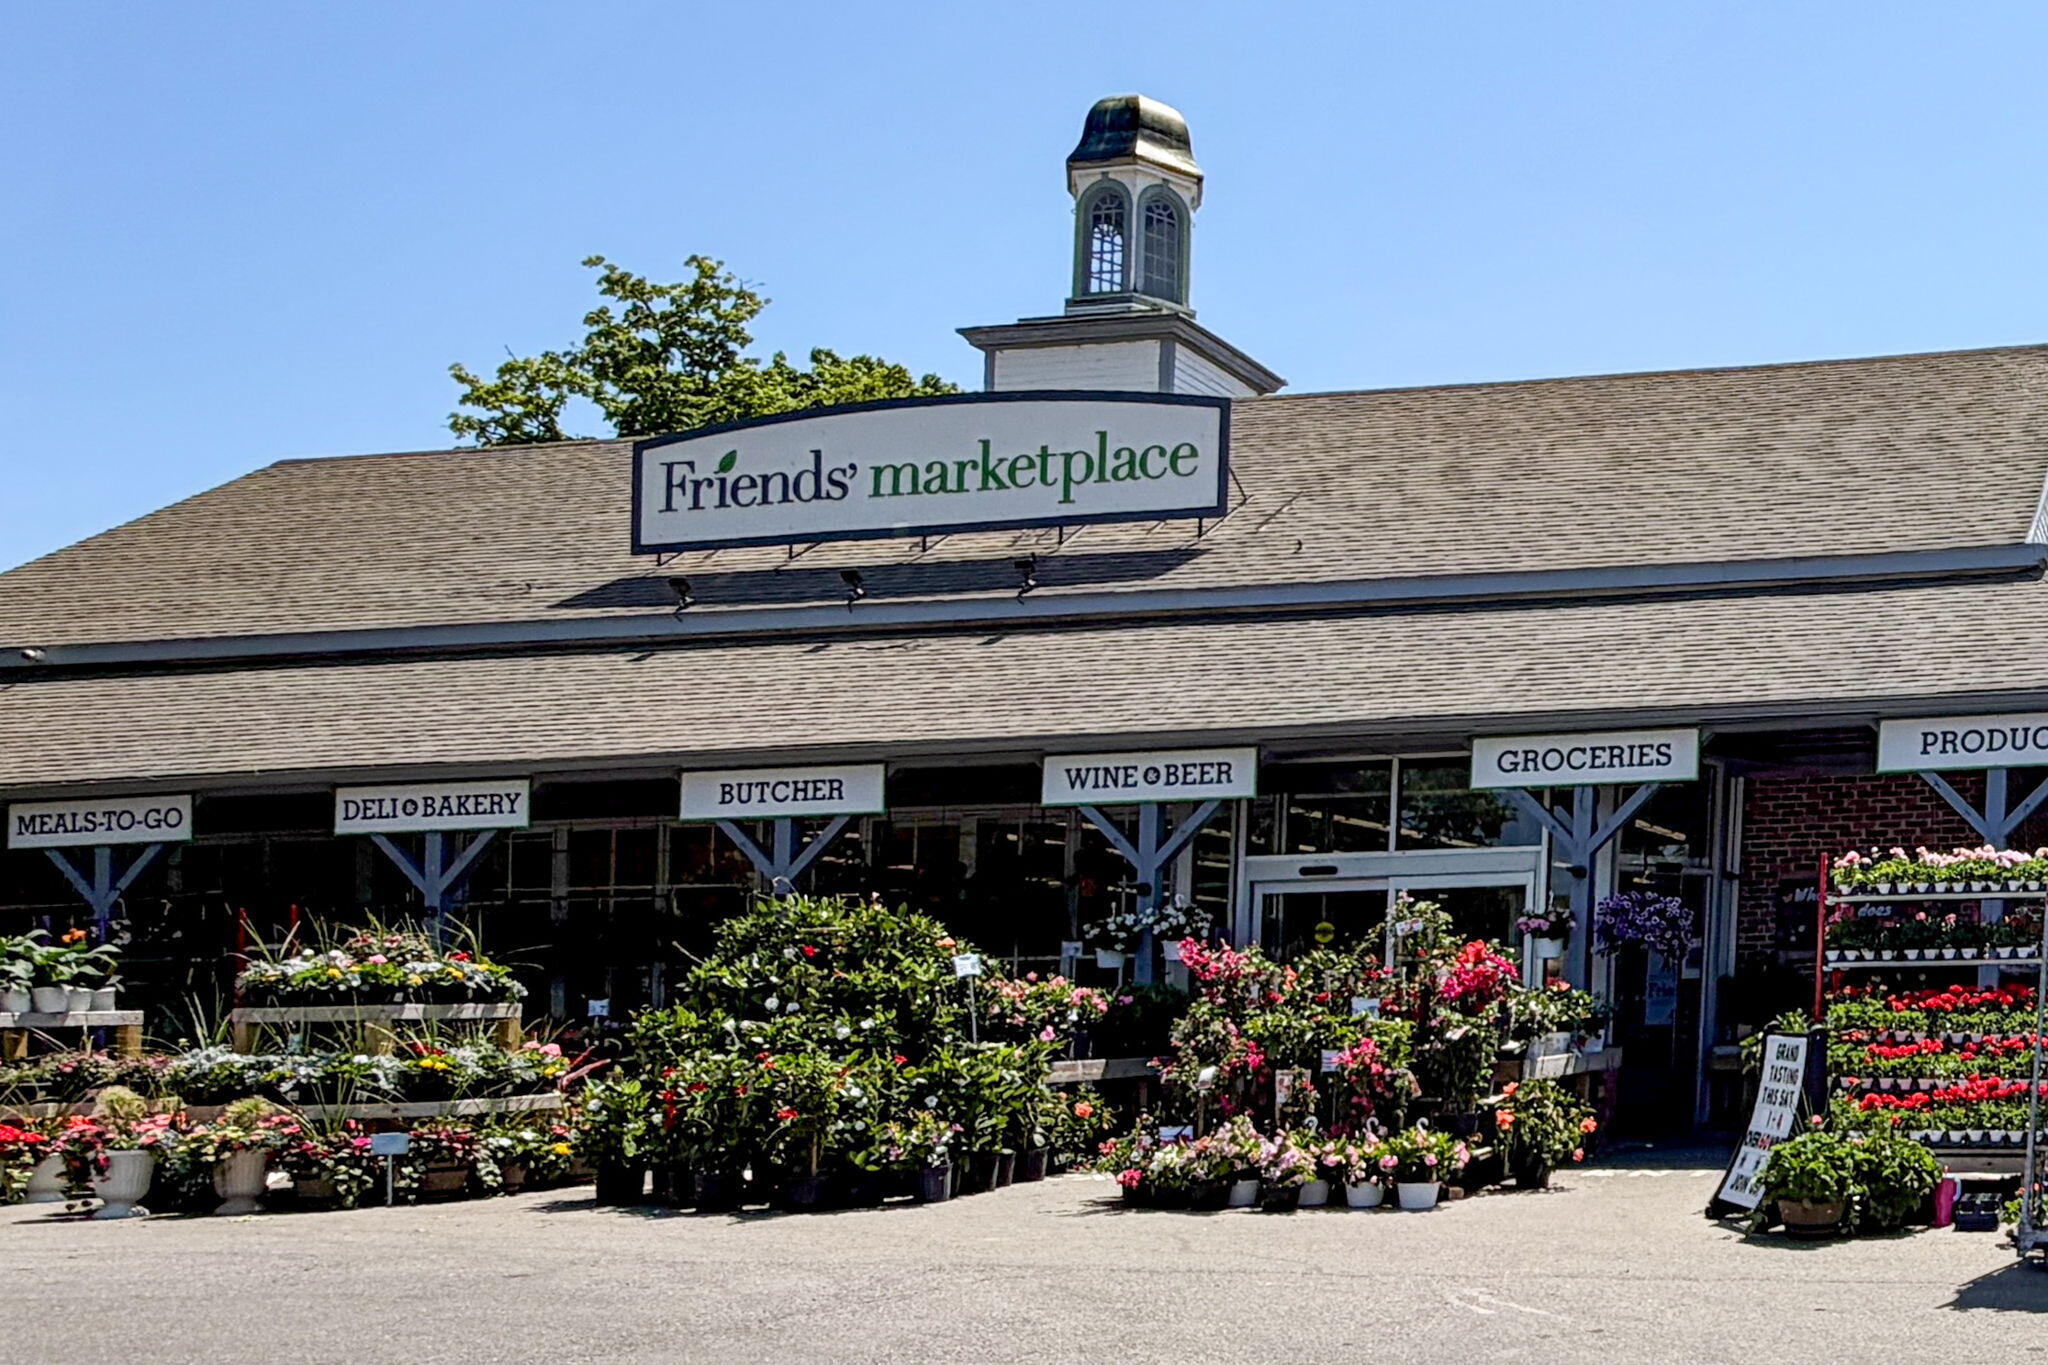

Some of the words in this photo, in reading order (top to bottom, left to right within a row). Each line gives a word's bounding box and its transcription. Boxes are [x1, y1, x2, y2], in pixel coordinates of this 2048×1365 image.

[868, 430, 1199, 504] marketplace
[1497, 743, 1672, 773] GROCERIES
[1065, 766, 1138, 790] WINE
[1164, 762, 1232, 786] BEER
[719, 779, 844, 804] BUTCHER
[343, 798, 399, 820] DELI
[422, 793, 521, 817] BAKERY
[17, 807, 183, 835] MEALS-TO-GO
[1776, 1043, 1800, 1063] GRAND
[1769, 1065, 1799, 1086] TASTING
[1762, 1086, 1779, 1104] THIS
